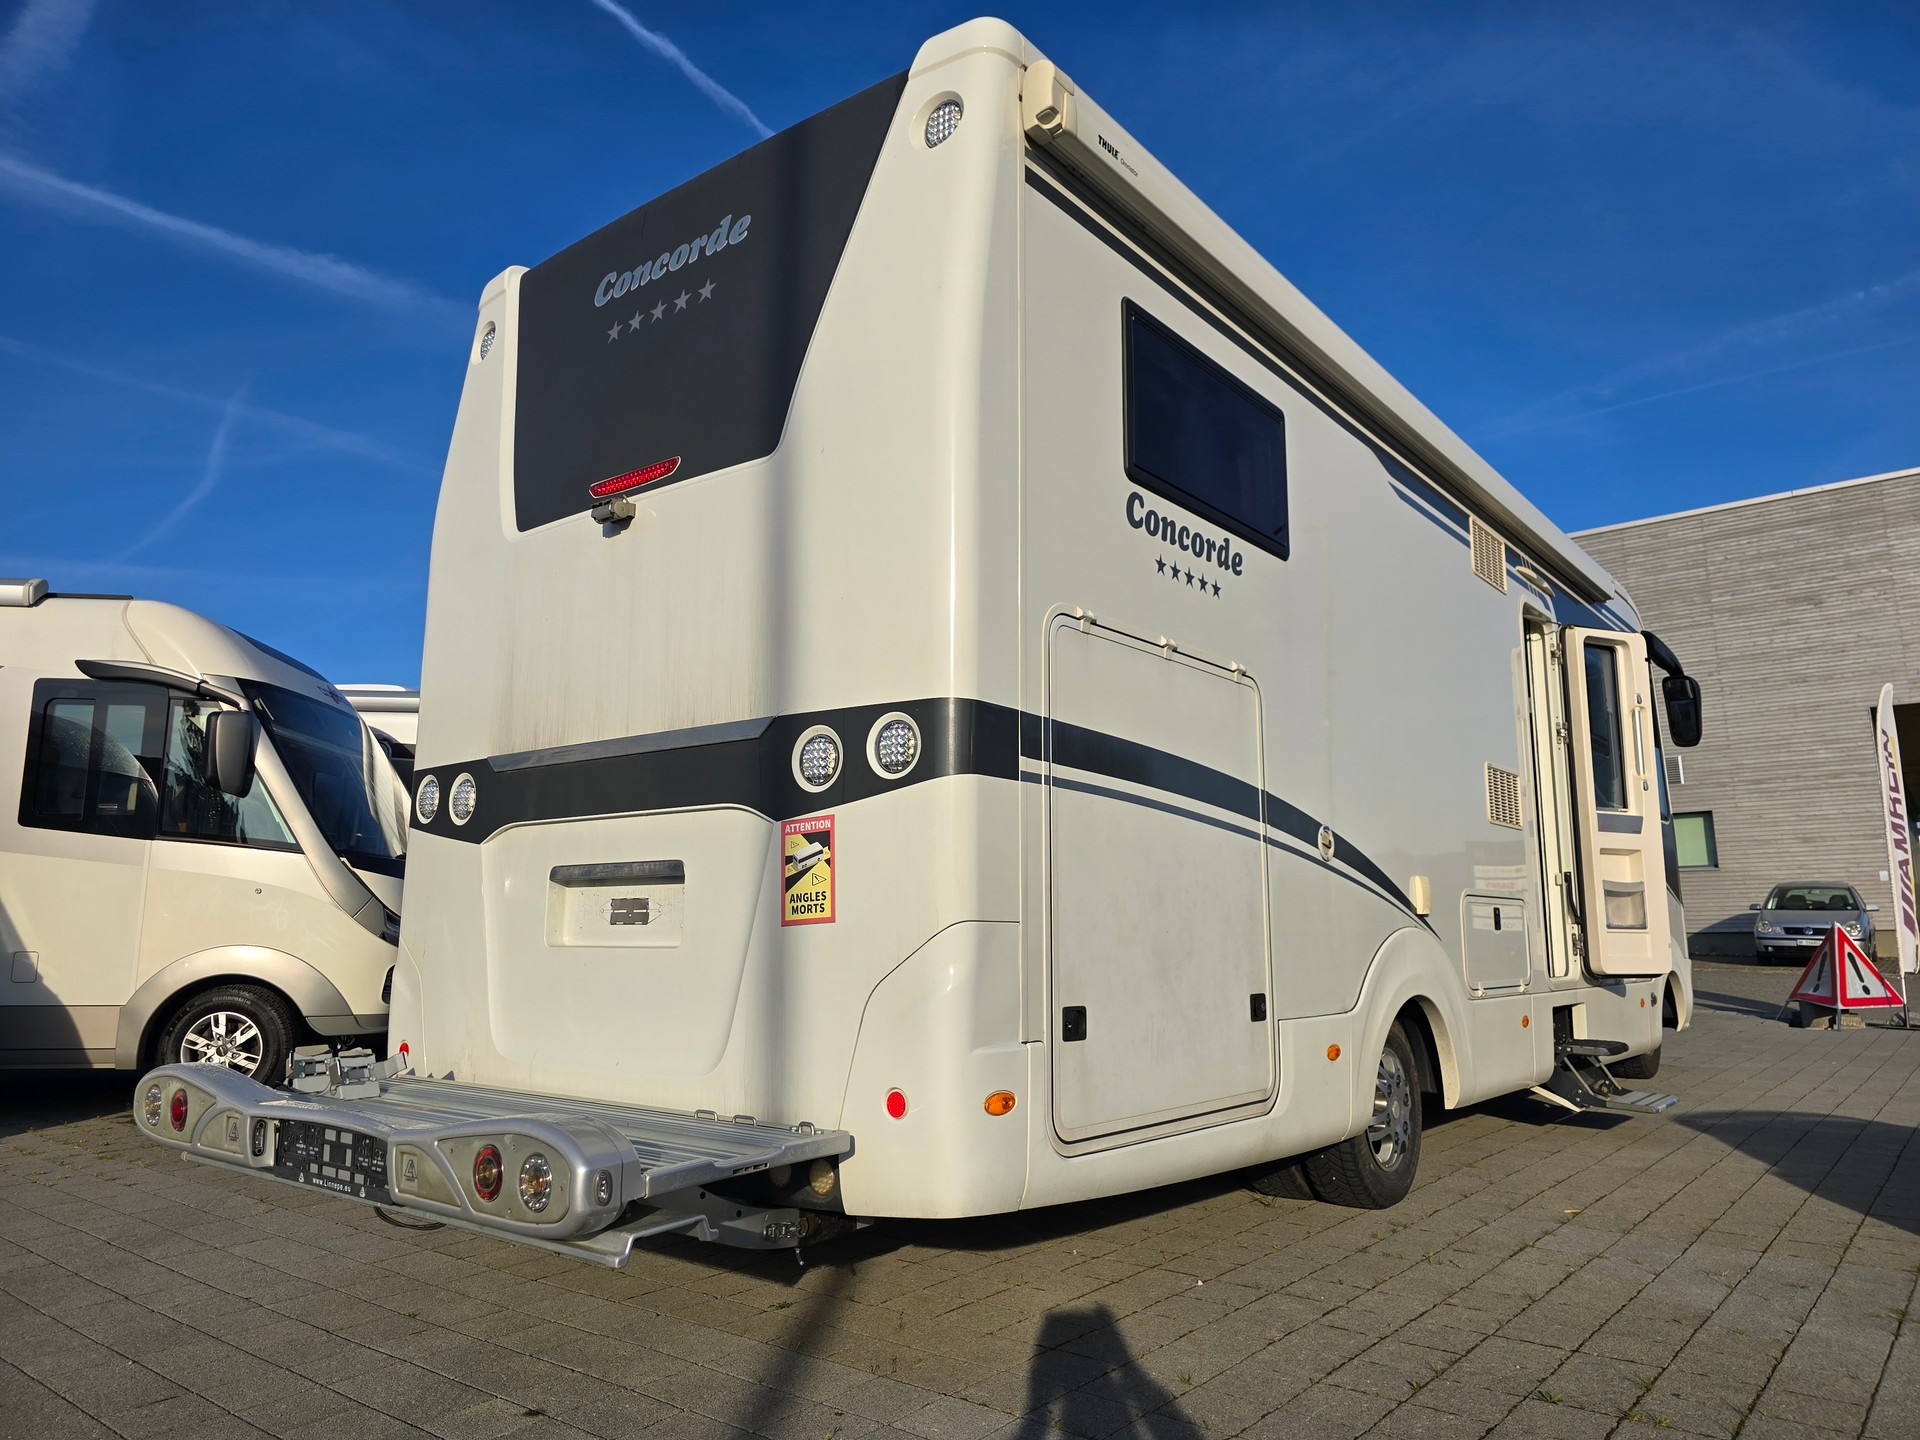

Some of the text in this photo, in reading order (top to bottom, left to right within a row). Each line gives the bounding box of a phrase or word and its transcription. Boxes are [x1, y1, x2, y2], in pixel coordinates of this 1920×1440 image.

[1097, 134, 1119, 160] THULE
[594, 214, 752, 308] Concorde
[1126, 491, 1243, 577] Concorde
[785, 819, 831, 834] ATTENTION
[789, 891, 827, 904] ANGLES
[791, 903, 825, 916] MORTS
